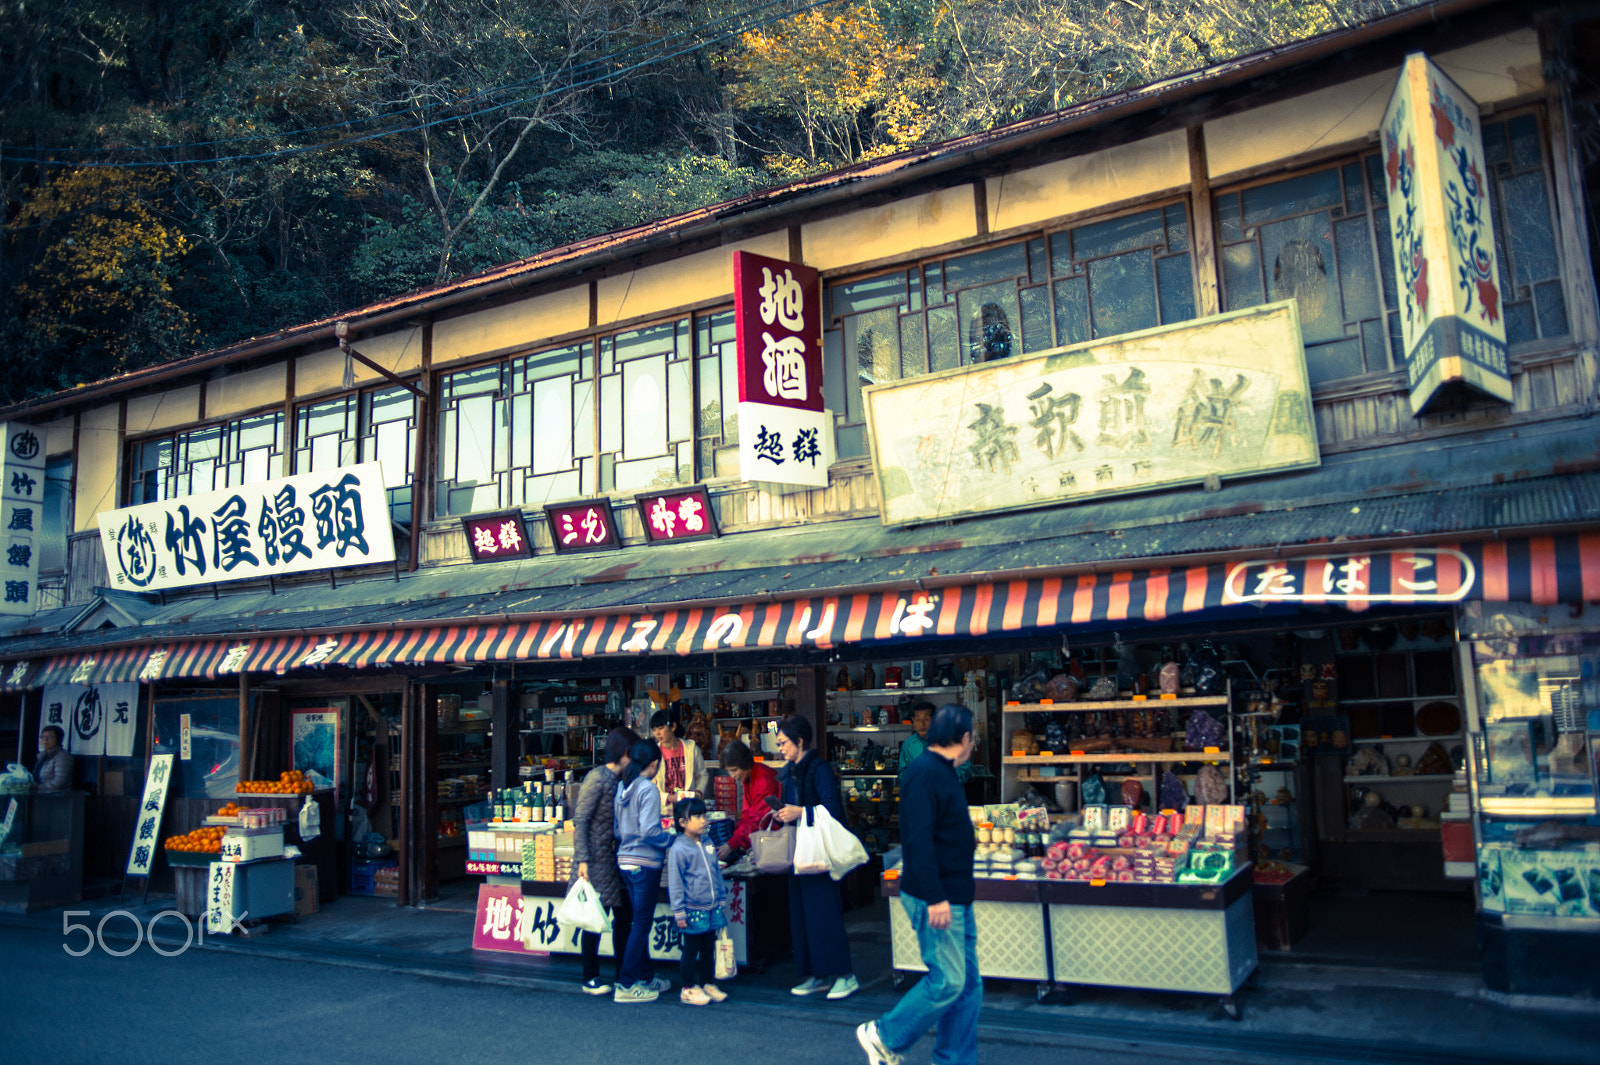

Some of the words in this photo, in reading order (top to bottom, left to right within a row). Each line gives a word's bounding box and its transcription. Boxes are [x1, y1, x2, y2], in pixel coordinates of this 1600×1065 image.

[758, 266, 808, 402] 地酒
[753, 424, 822, 468] 超群
[5, 471, 37, 604] 竹屋饅頭
[164, 472, 370, 577] 竹屋饅頭
[474, 520, 522, 553] 超群
[1254, 556, 1438, 594] たばこ
[541, 594, 940, 654] バスのりば
[133, 760, 168, 868] 竹屋饅頭
